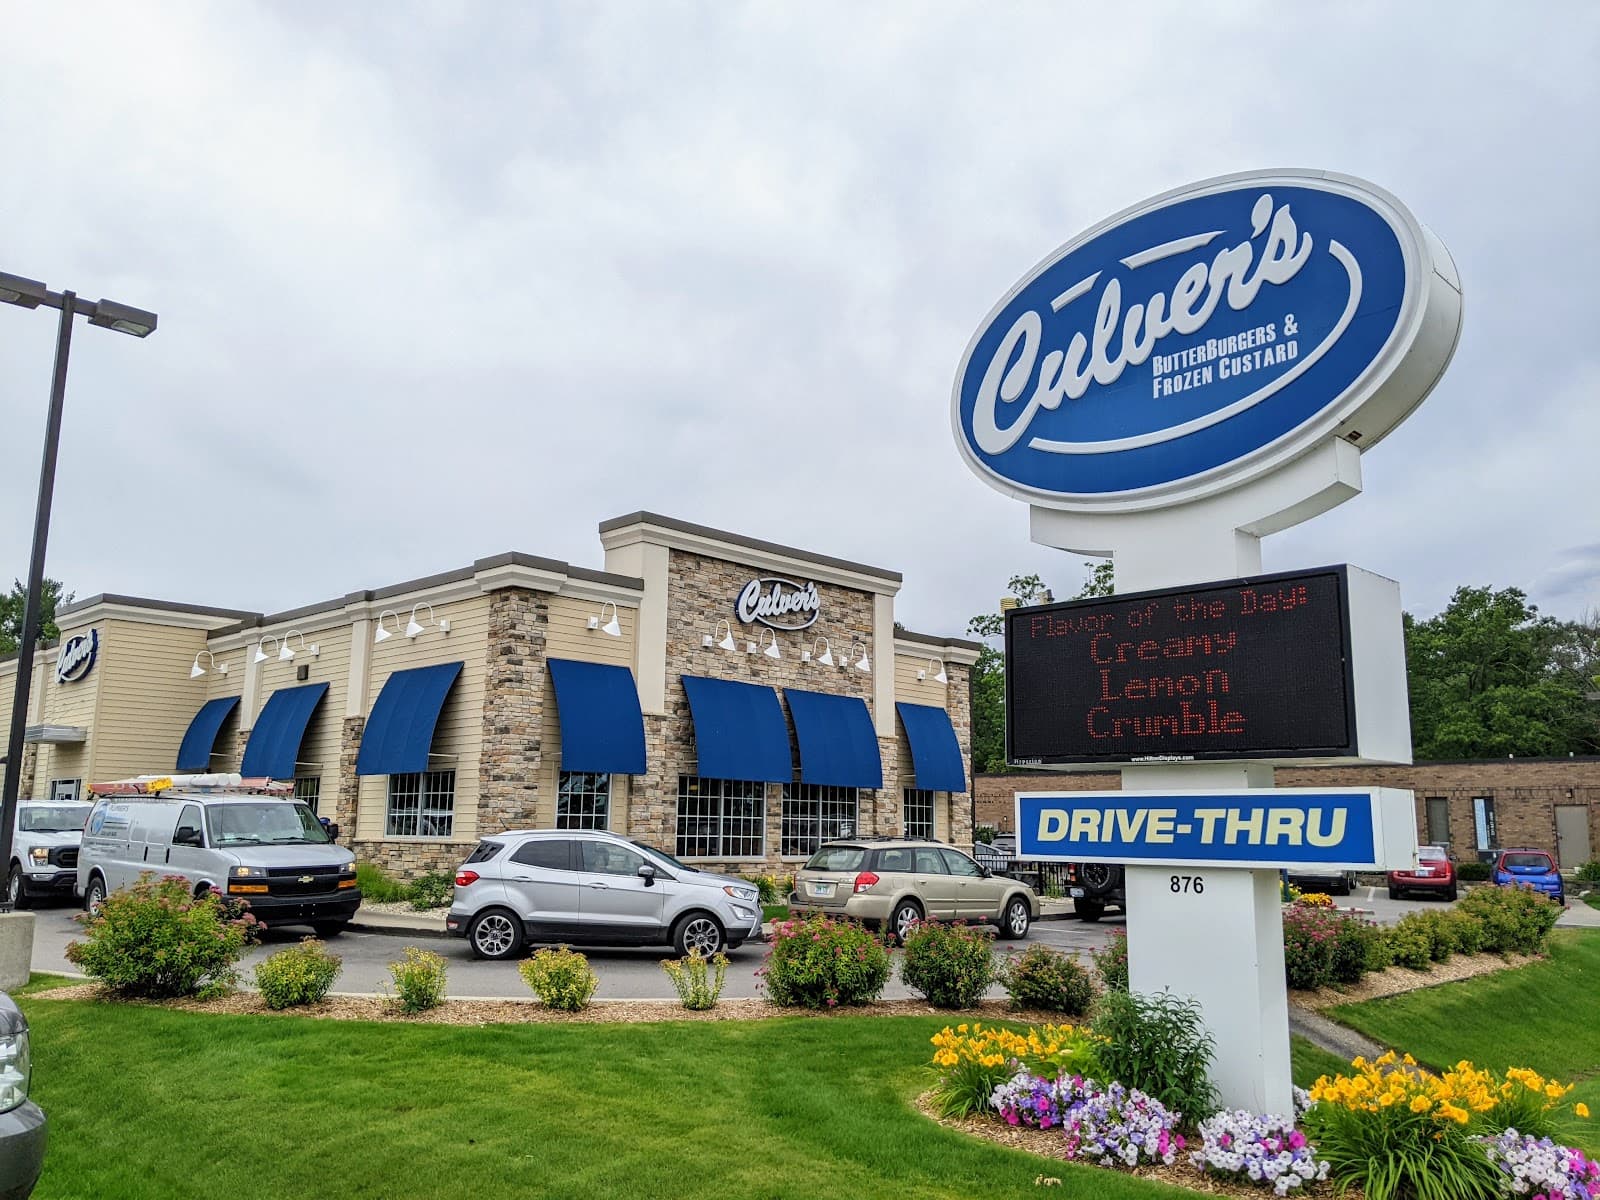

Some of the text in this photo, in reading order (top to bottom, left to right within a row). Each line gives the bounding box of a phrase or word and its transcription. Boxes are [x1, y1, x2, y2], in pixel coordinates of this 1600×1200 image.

[972, 193, 1313, 456] Culver's
[1283, 313, 1299, 337] &
[738, 579, 821, 623] Culver's
[1030, 584, 1310, 639] Flavor of the Day:
[1089, 631, 1238, 665] Creamy
[1098, 668, 1231, 701] Lemon
[1086, 699, 1249, 740] Crumble
[1036, 807, 1348, 848] DRIVE-THRU
[1169, 875, 1205, 895] 876
